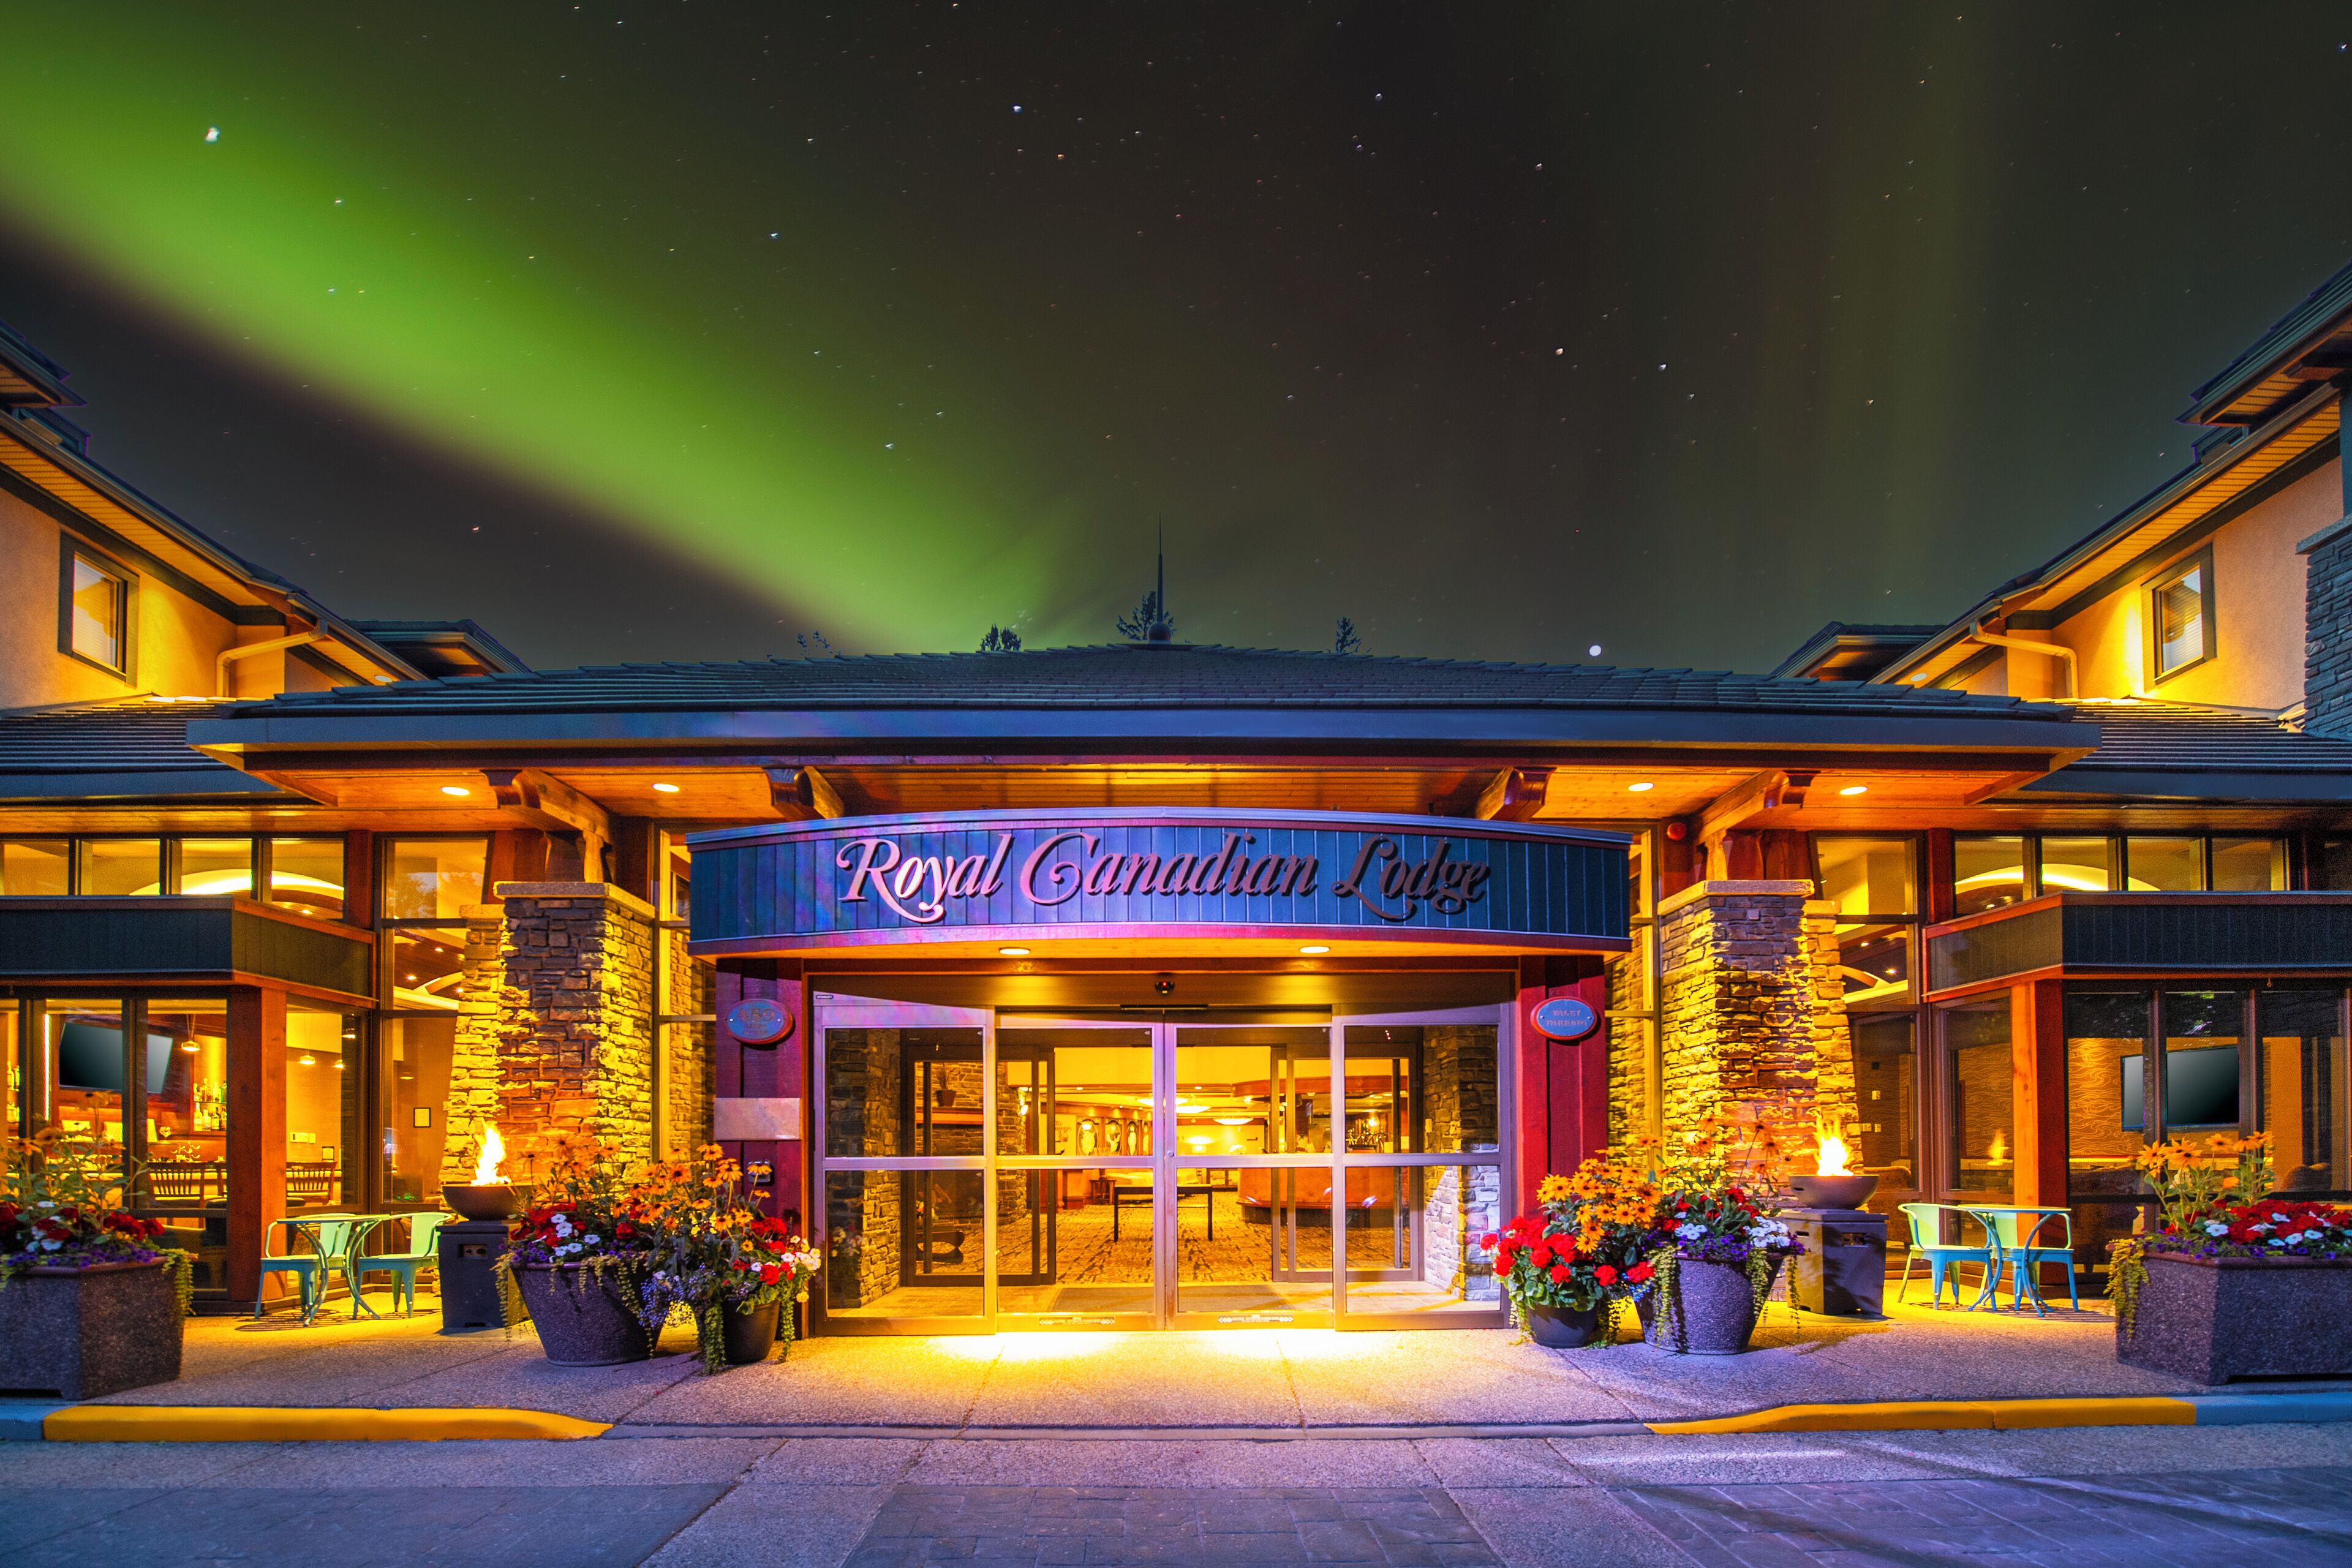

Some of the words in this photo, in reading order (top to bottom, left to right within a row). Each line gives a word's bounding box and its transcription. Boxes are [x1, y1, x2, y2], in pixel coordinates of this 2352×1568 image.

[835, 833, 1013, 922] Royal
[1019, 831, 1316, 905] Canadian
[1330, 835, 1488, 919] Lodge
